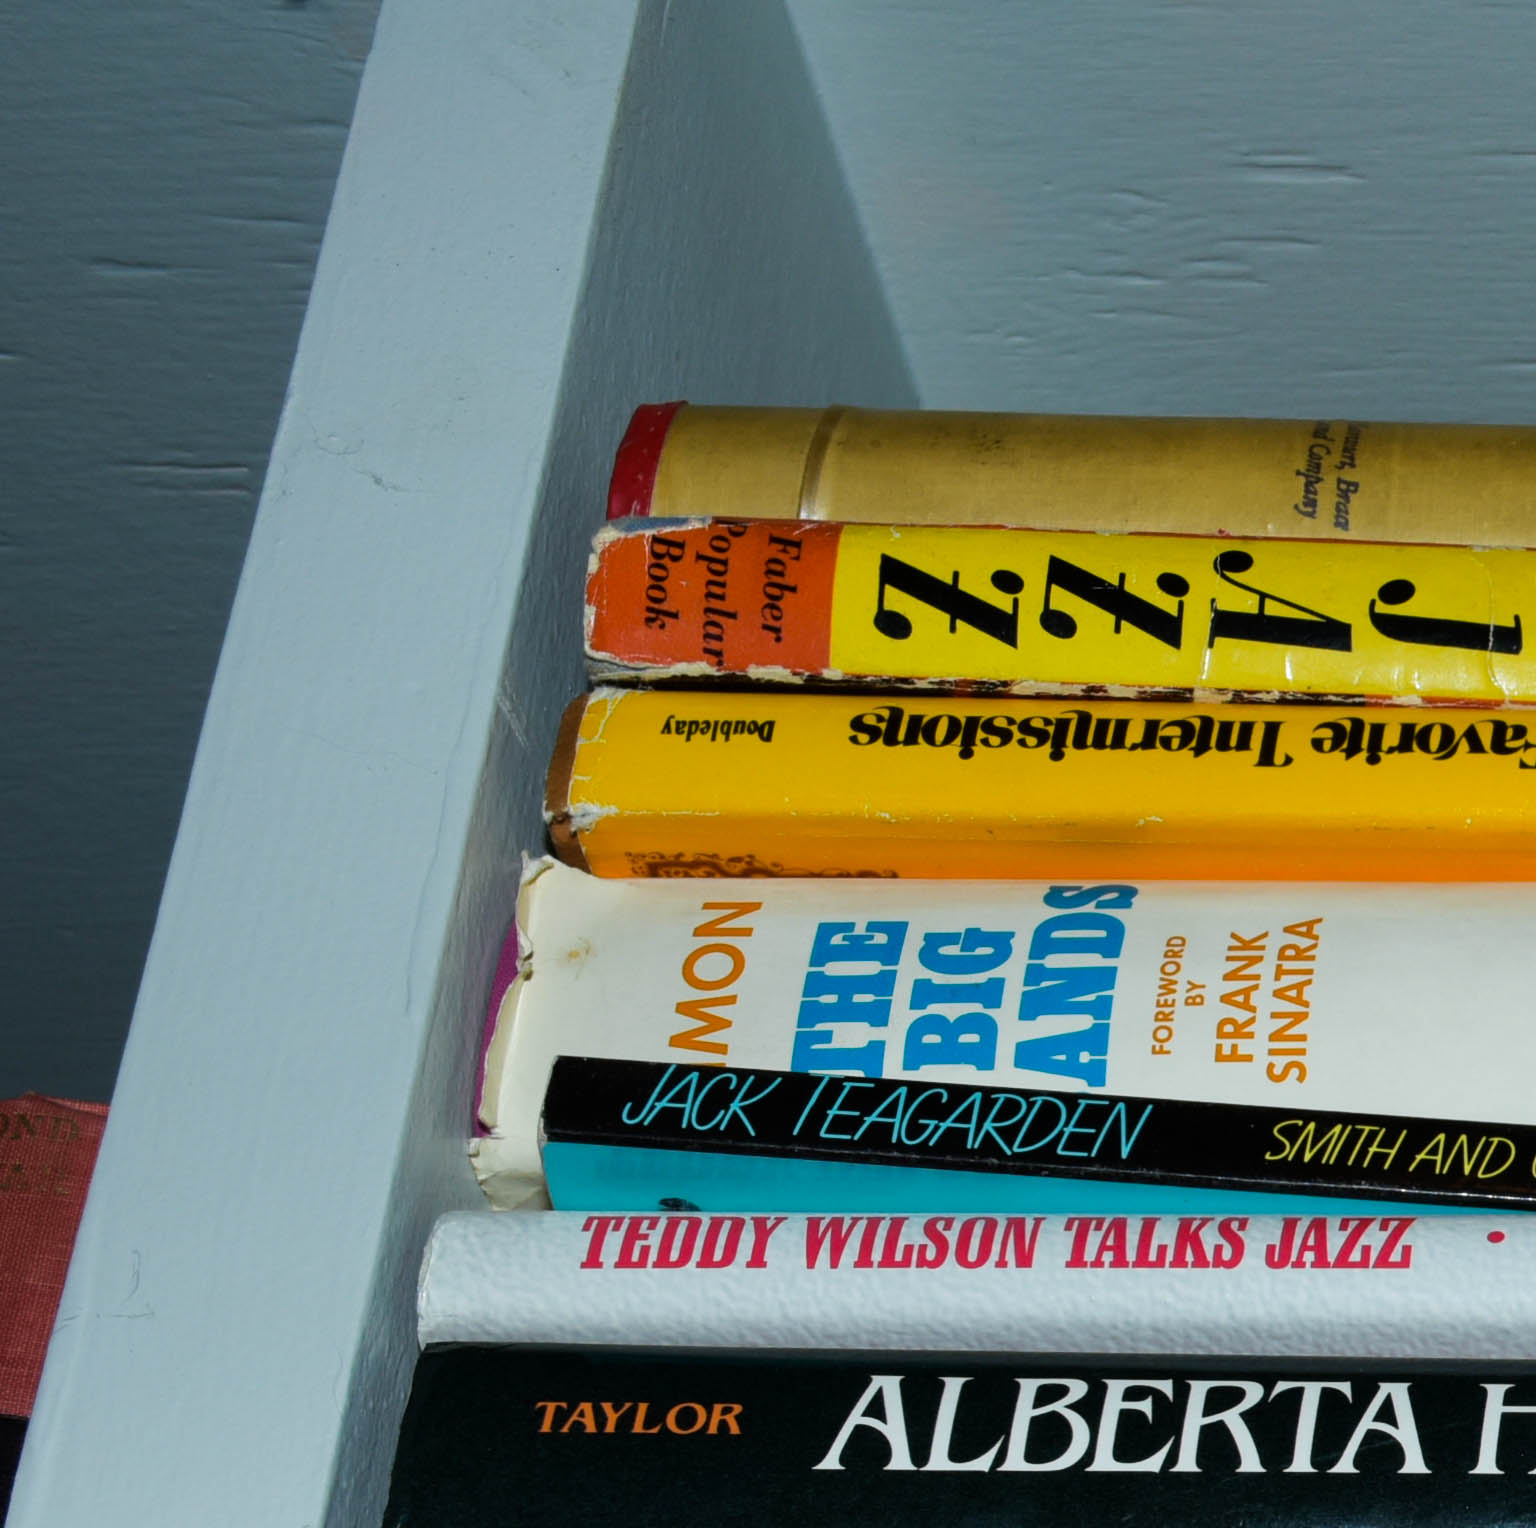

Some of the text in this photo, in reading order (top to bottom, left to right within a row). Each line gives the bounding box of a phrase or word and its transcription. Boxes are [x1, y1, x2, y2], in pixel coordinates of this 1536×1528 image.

[1294, 443, 1331, 519] Company
[644, 535, 686, 630] Book
[695, 520, 747, 667] Popular
[761, 534, 803, 643] Faber
[660, 715, 776, 743] Doubleday
[848, 706, 1294, 767] Intermissions
[668, 902, 763, 1067] MON
[790, 921, 909, 1078] THE
[902, 927, 1016, 1071] BIG
[1013, 884, 1139, 1088] ANDS
[1151, 935, 1186, 1055] FOREWORD
[1184, 980, 1207, 1007] BY
[1214, 931, 1269, 1063] FRANK
[1265, 917, 1324, 1084] SINATRA
[621, 1063, 1154, 1160] JACK TEAGARDEN
[1264, 1119, 1408, 1170] SMITH
[1409, 1133, 1517, 1180] AND
[579, 1215, 1417, 1269] TEDDY WILSON TALKS JAZZ
[534, 1401, 743, 1436] TAYLOR
[810, 1375, 1432, 1474] ALBERTA
